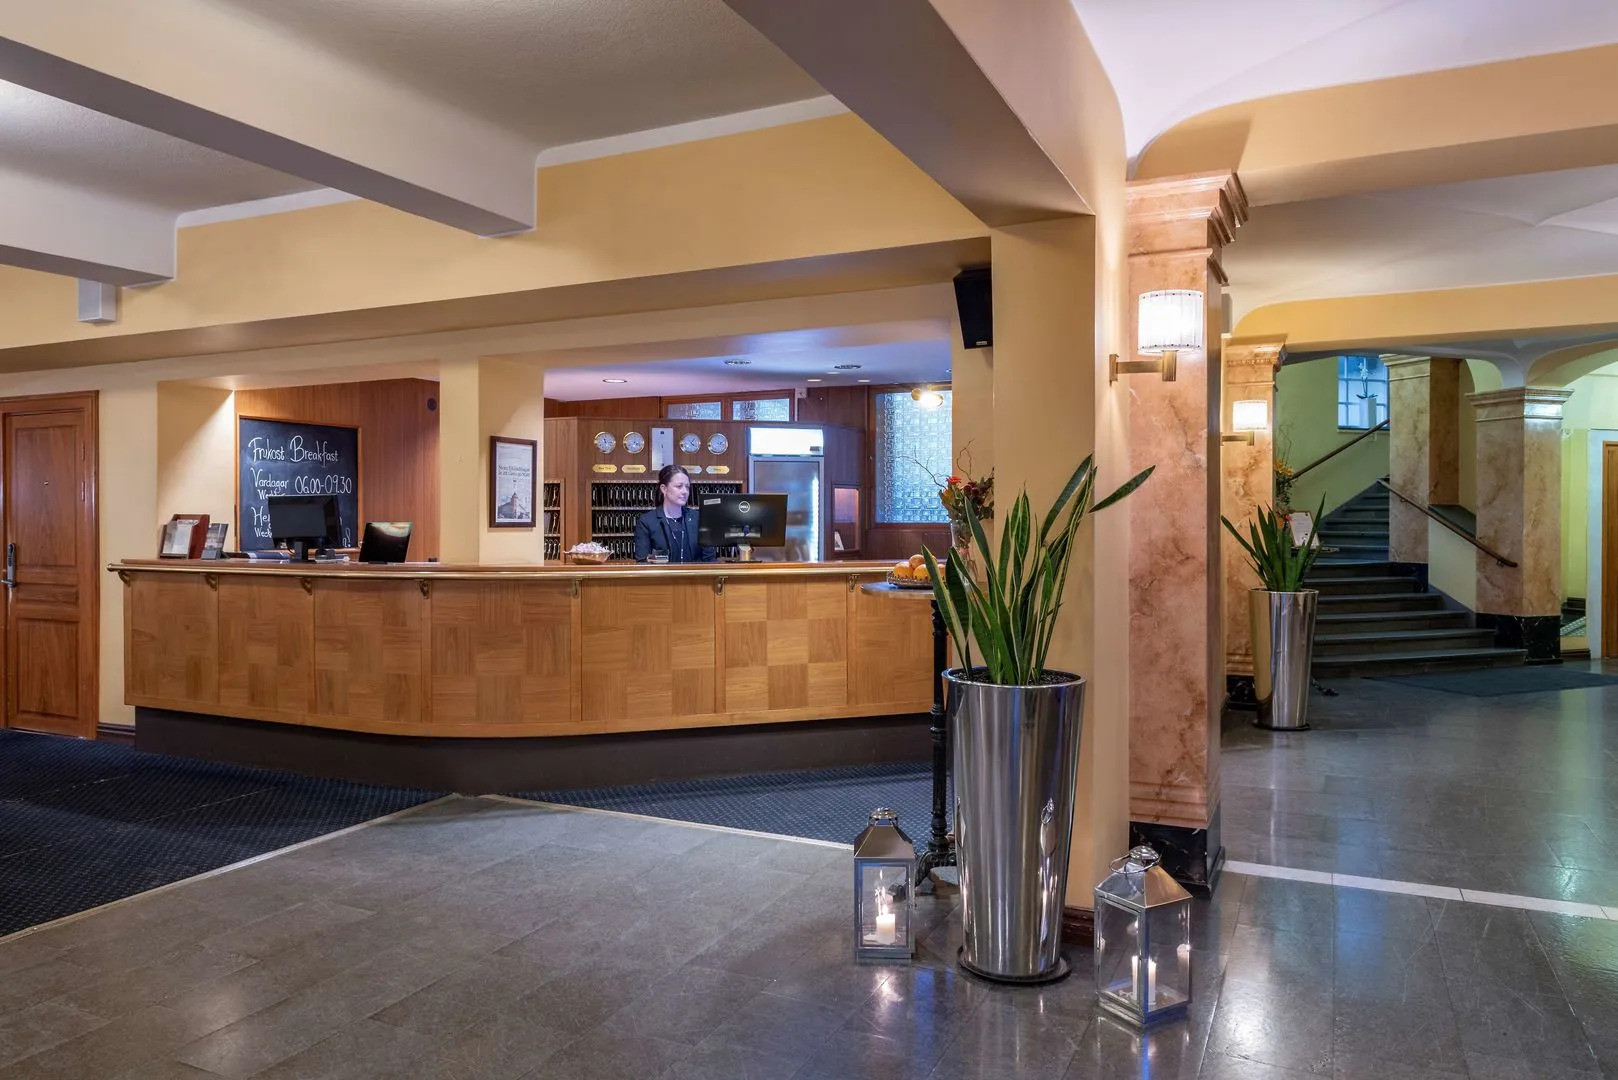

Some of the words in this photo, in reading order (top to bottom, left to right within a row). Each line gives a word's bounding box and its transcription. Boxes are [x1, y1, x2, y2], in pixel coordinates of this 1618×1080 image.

[248, 436, 285, 463] Frukost
[290, 435, 338, 468] Breakfast
[250, 467, 289, 493] Vardagar
